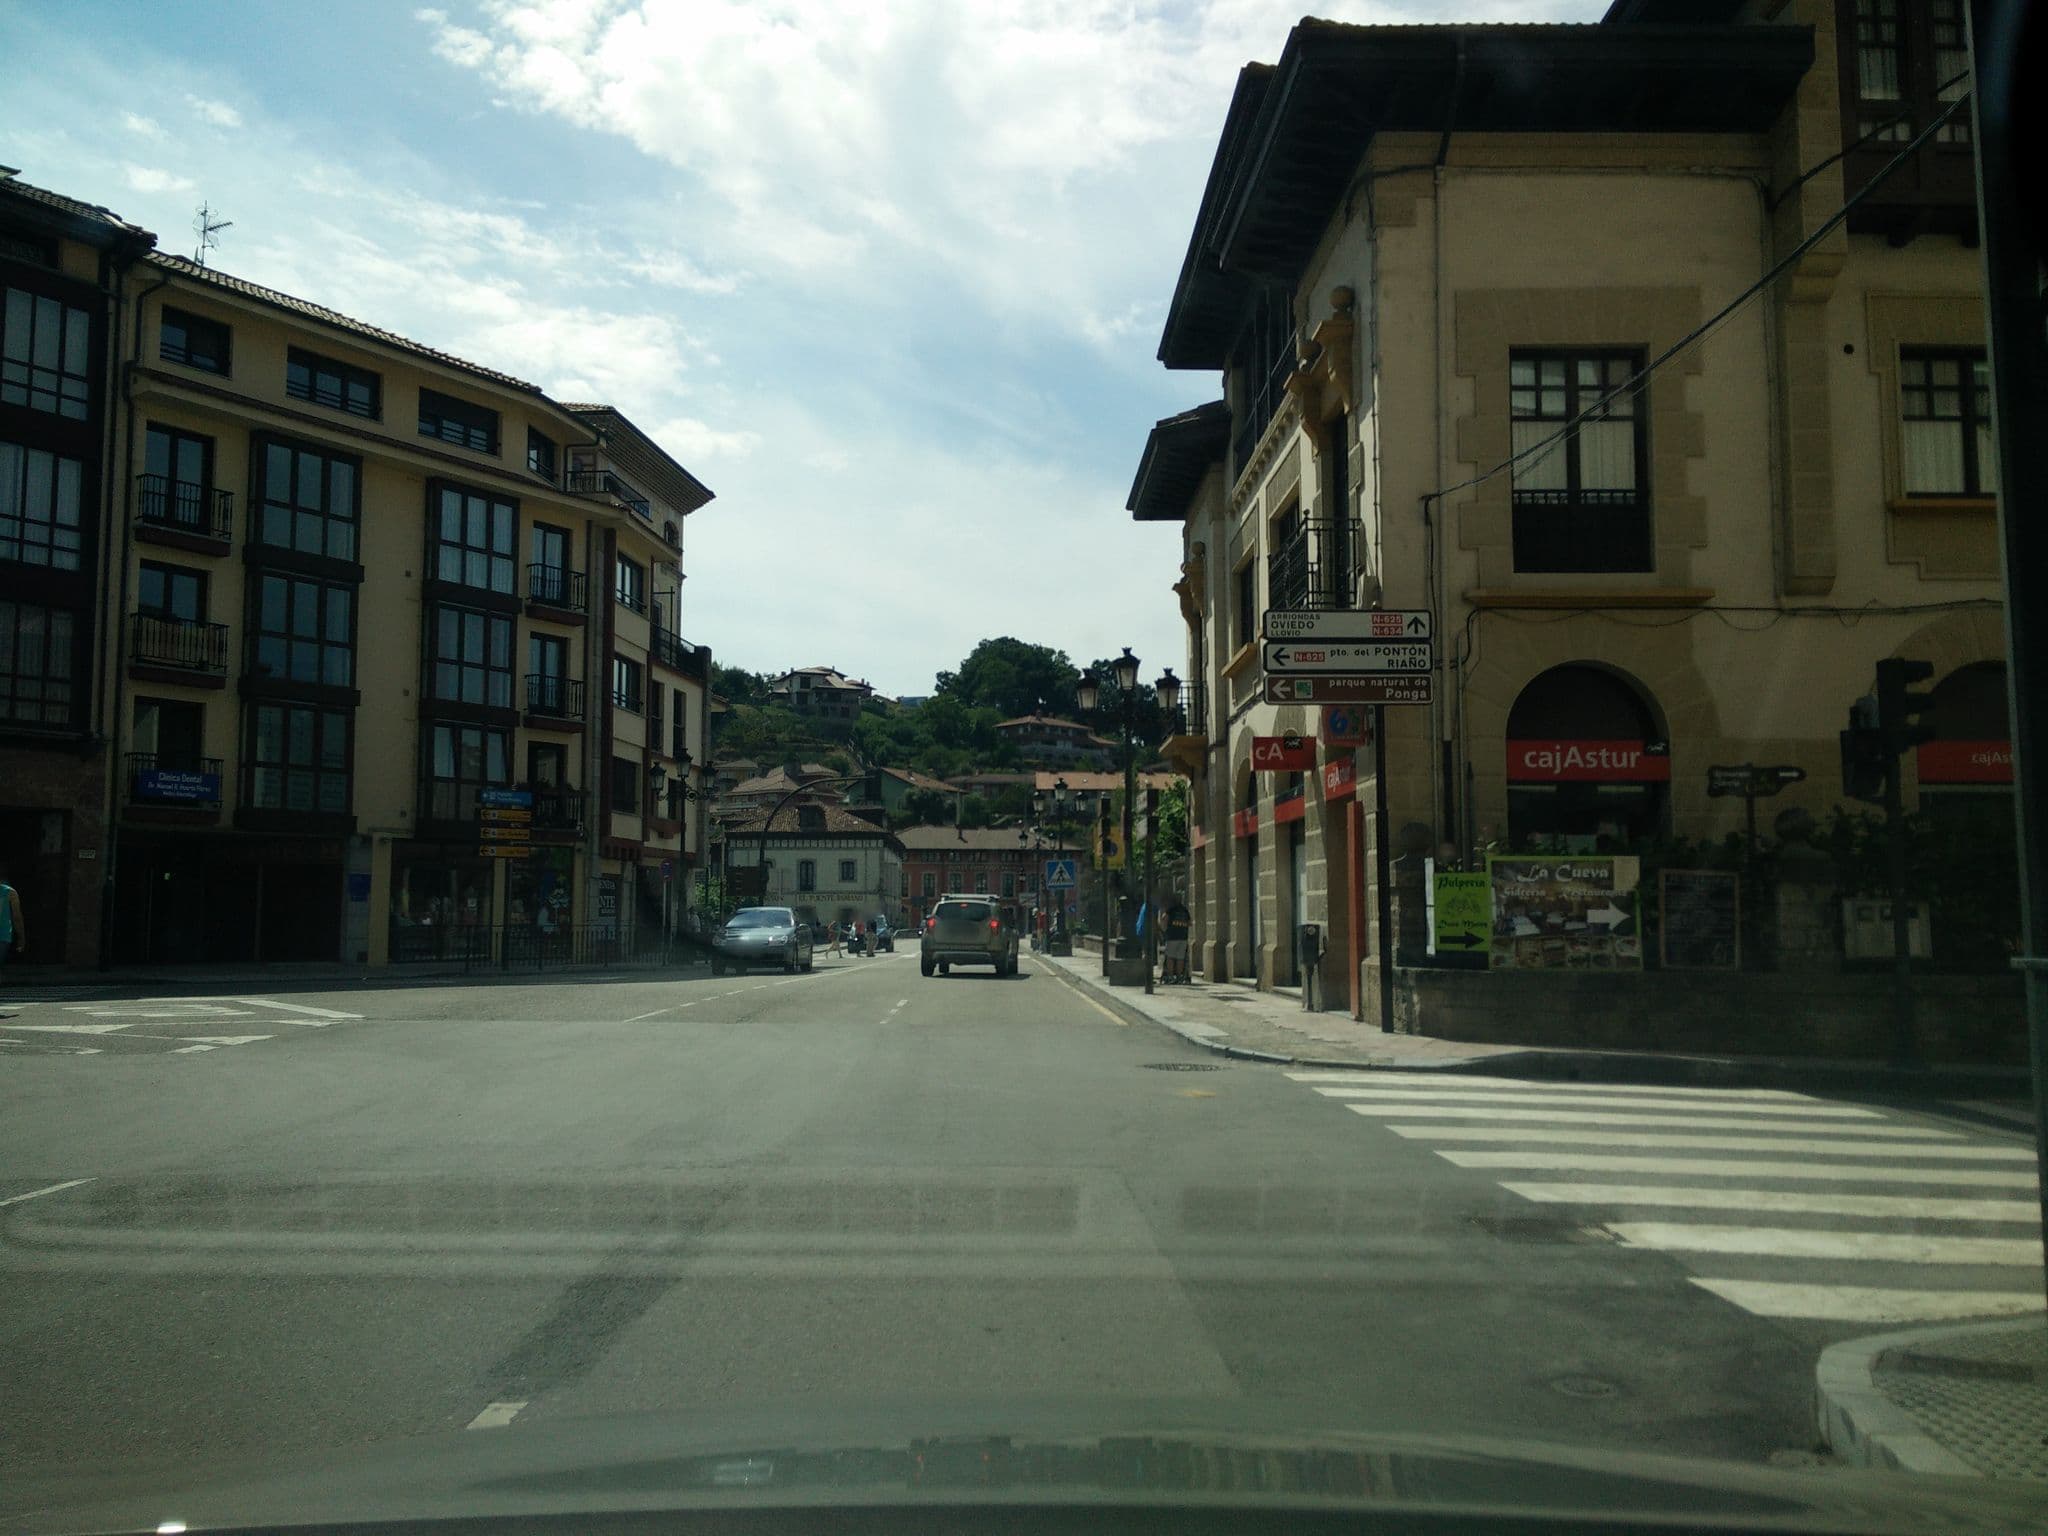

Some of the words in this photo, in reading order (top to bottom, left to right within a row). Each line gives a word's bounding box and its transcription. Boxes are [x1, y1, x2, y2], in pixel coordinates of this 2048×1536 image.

[1271, 620, 1315, 629] OVIEDO
[1373, 615, 1402, 624] N-625
[1373, 626, 1403, 635] N-634
[1354, 647, 1370, 656] del
[1374, 645, 1426, 656] PONTÓN
[1387, 657, 1427, 668] RIAÑO
[1329, 679, 1366, 688] parque
[1370, 677, 1409, 686] natural
[1414, 677, 1428, 687] de
[1385, 688, 1427, 700] Ponga
[1255, 743, 1284, 761] cA
[1523, 744, 1641, 775] cajAstur
[1516, 864, 1549, 882] La
[1555, 864, 1609, 882] Cueva
